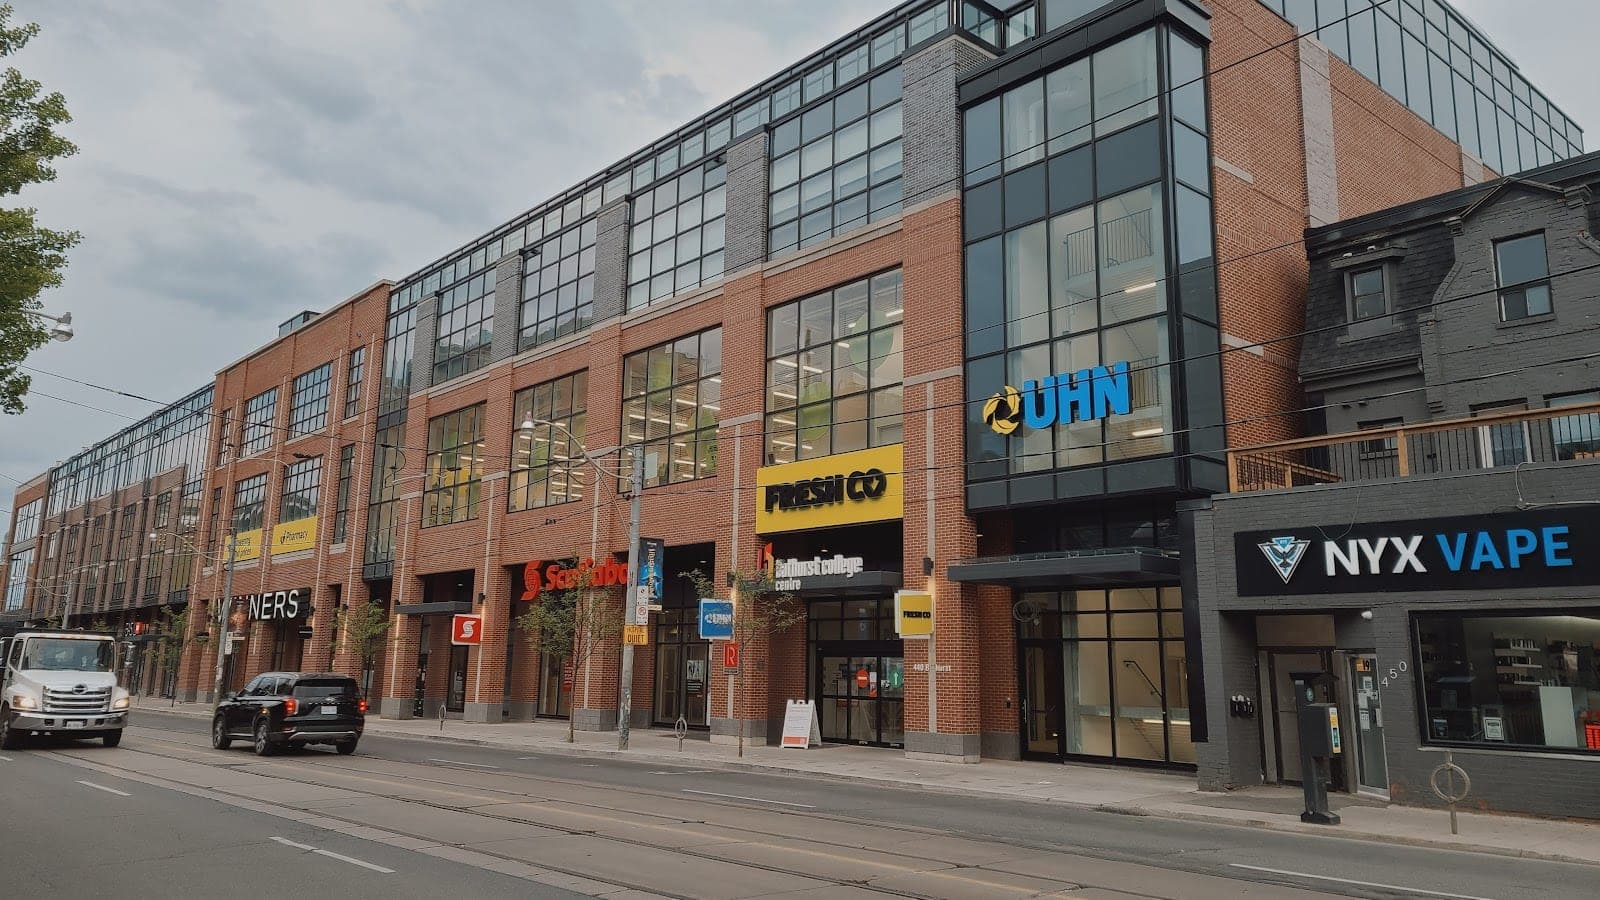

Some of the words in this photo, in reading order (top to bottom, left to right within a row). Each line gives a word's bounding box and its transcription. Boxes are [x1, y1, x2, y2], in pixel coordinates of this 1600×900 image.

[1023, 360, 1133, 429] UHN
[765, 474, 844, 512] FRESH
[846, 468, 887, 500] CO
[286, 530, 308, 541] Pharmacy
[1324, 535, 1427, 577] NYX
[1436, 526, 1573, 572] VAPE
[775, 556, 821, 578] Bathurst
[821, 554, 863, 577] college
[775, 577, 802, 591] centre
[627, 634, 644, 643] QUIET
[727, 646, 735, 665] R
[913, 663, 924, 671] 440
[1381, 660, 1407, 687] 450
